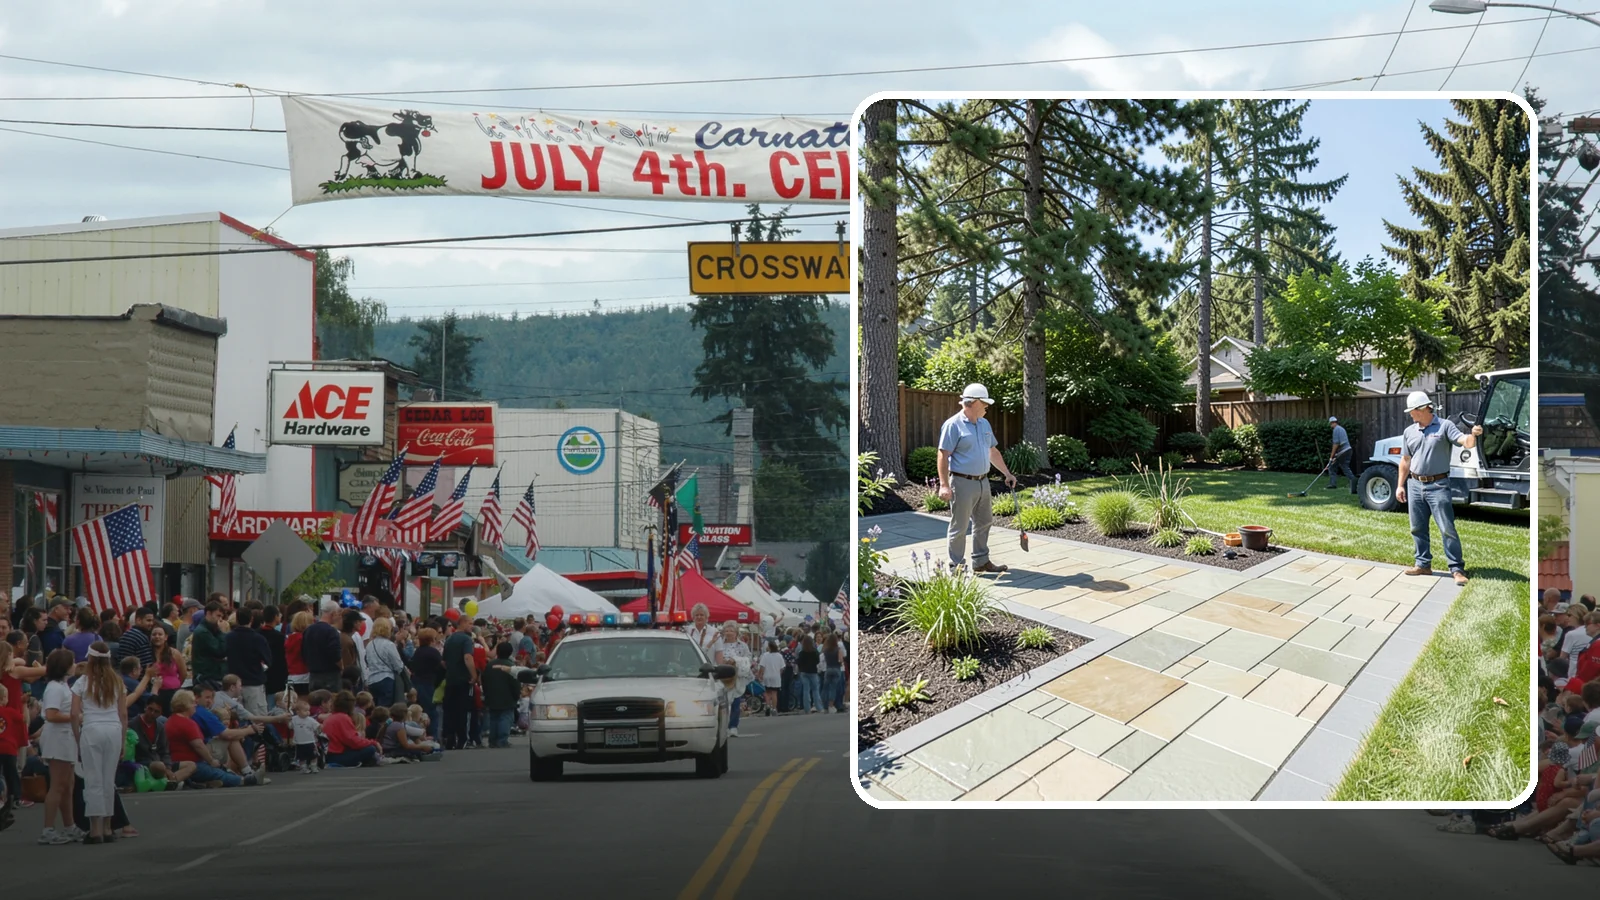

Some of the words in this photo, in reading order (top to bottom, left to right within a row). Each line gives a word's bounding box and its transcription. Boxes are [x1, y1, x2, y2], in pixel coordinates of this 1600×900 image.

[695, 121, 850, 149] Carnat
[481, 141, 603, 192] JULY
[631, 150, 746, 197] 4th.
[697, 254, 850, 280] CROSSWA
[283, 380, 373, 420] ACE
[406, 410, 452, 422] CEDAR
[284, 421, 370, 436] Hardware
[353, 467, 385, 480] Simpl
[95, 485, 124, 494] Vincent
[126, 486, 135, 494] de
[138, 486, 154, 494] Paul
[688, 526, 741, 534] CRNATION
[699, 535, 730, 543] GLASS
